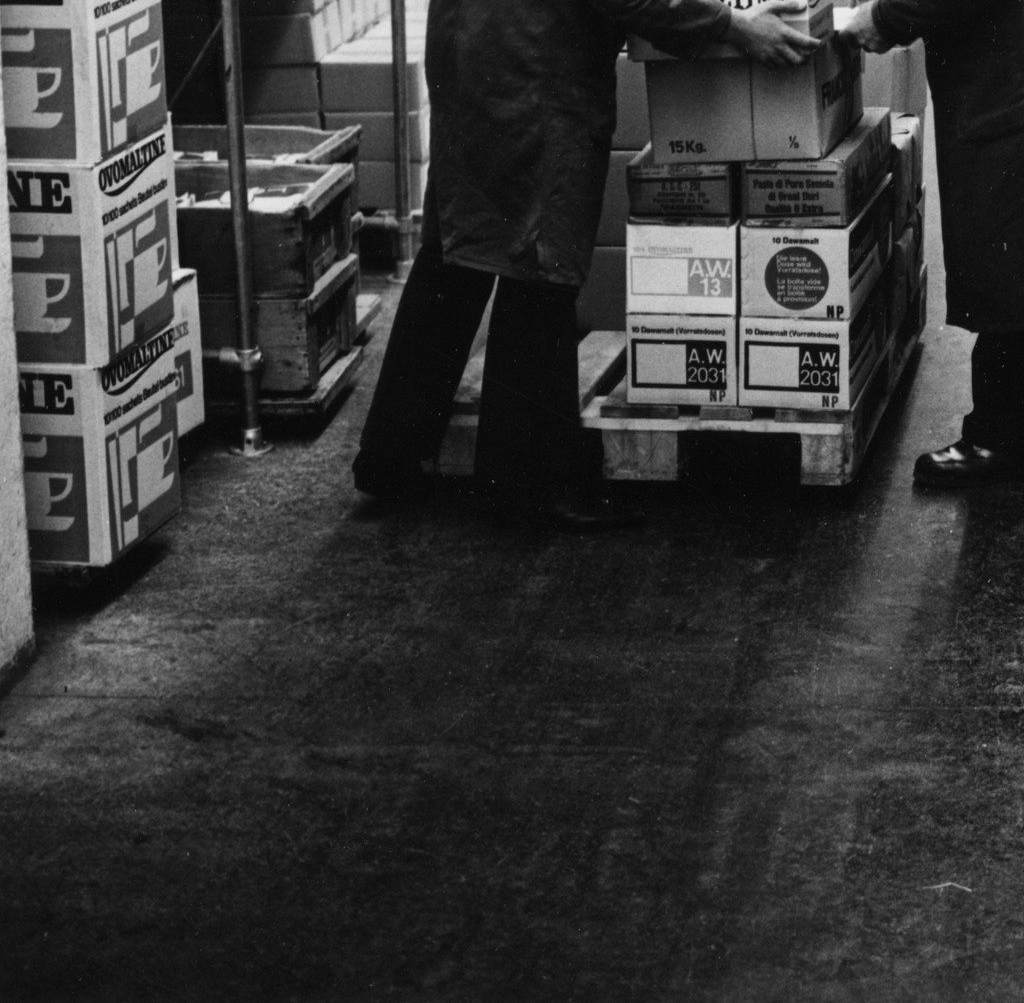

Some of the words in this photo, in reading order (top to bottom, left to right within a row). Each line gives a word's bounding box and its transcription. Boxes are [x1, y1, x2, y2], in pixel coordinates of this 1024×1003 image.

[99, 133, 166, 192] OVOMALTINE
[753, 180, 774, 189] Pasta
[689, 259, 731, 278] A.W.
[700, 278, 721, 296] 13
[101, 328, 174, 392] OVOMALTINE
[687, 367, 726, 383] 2031
[800, 369, 838, 387] 2031
